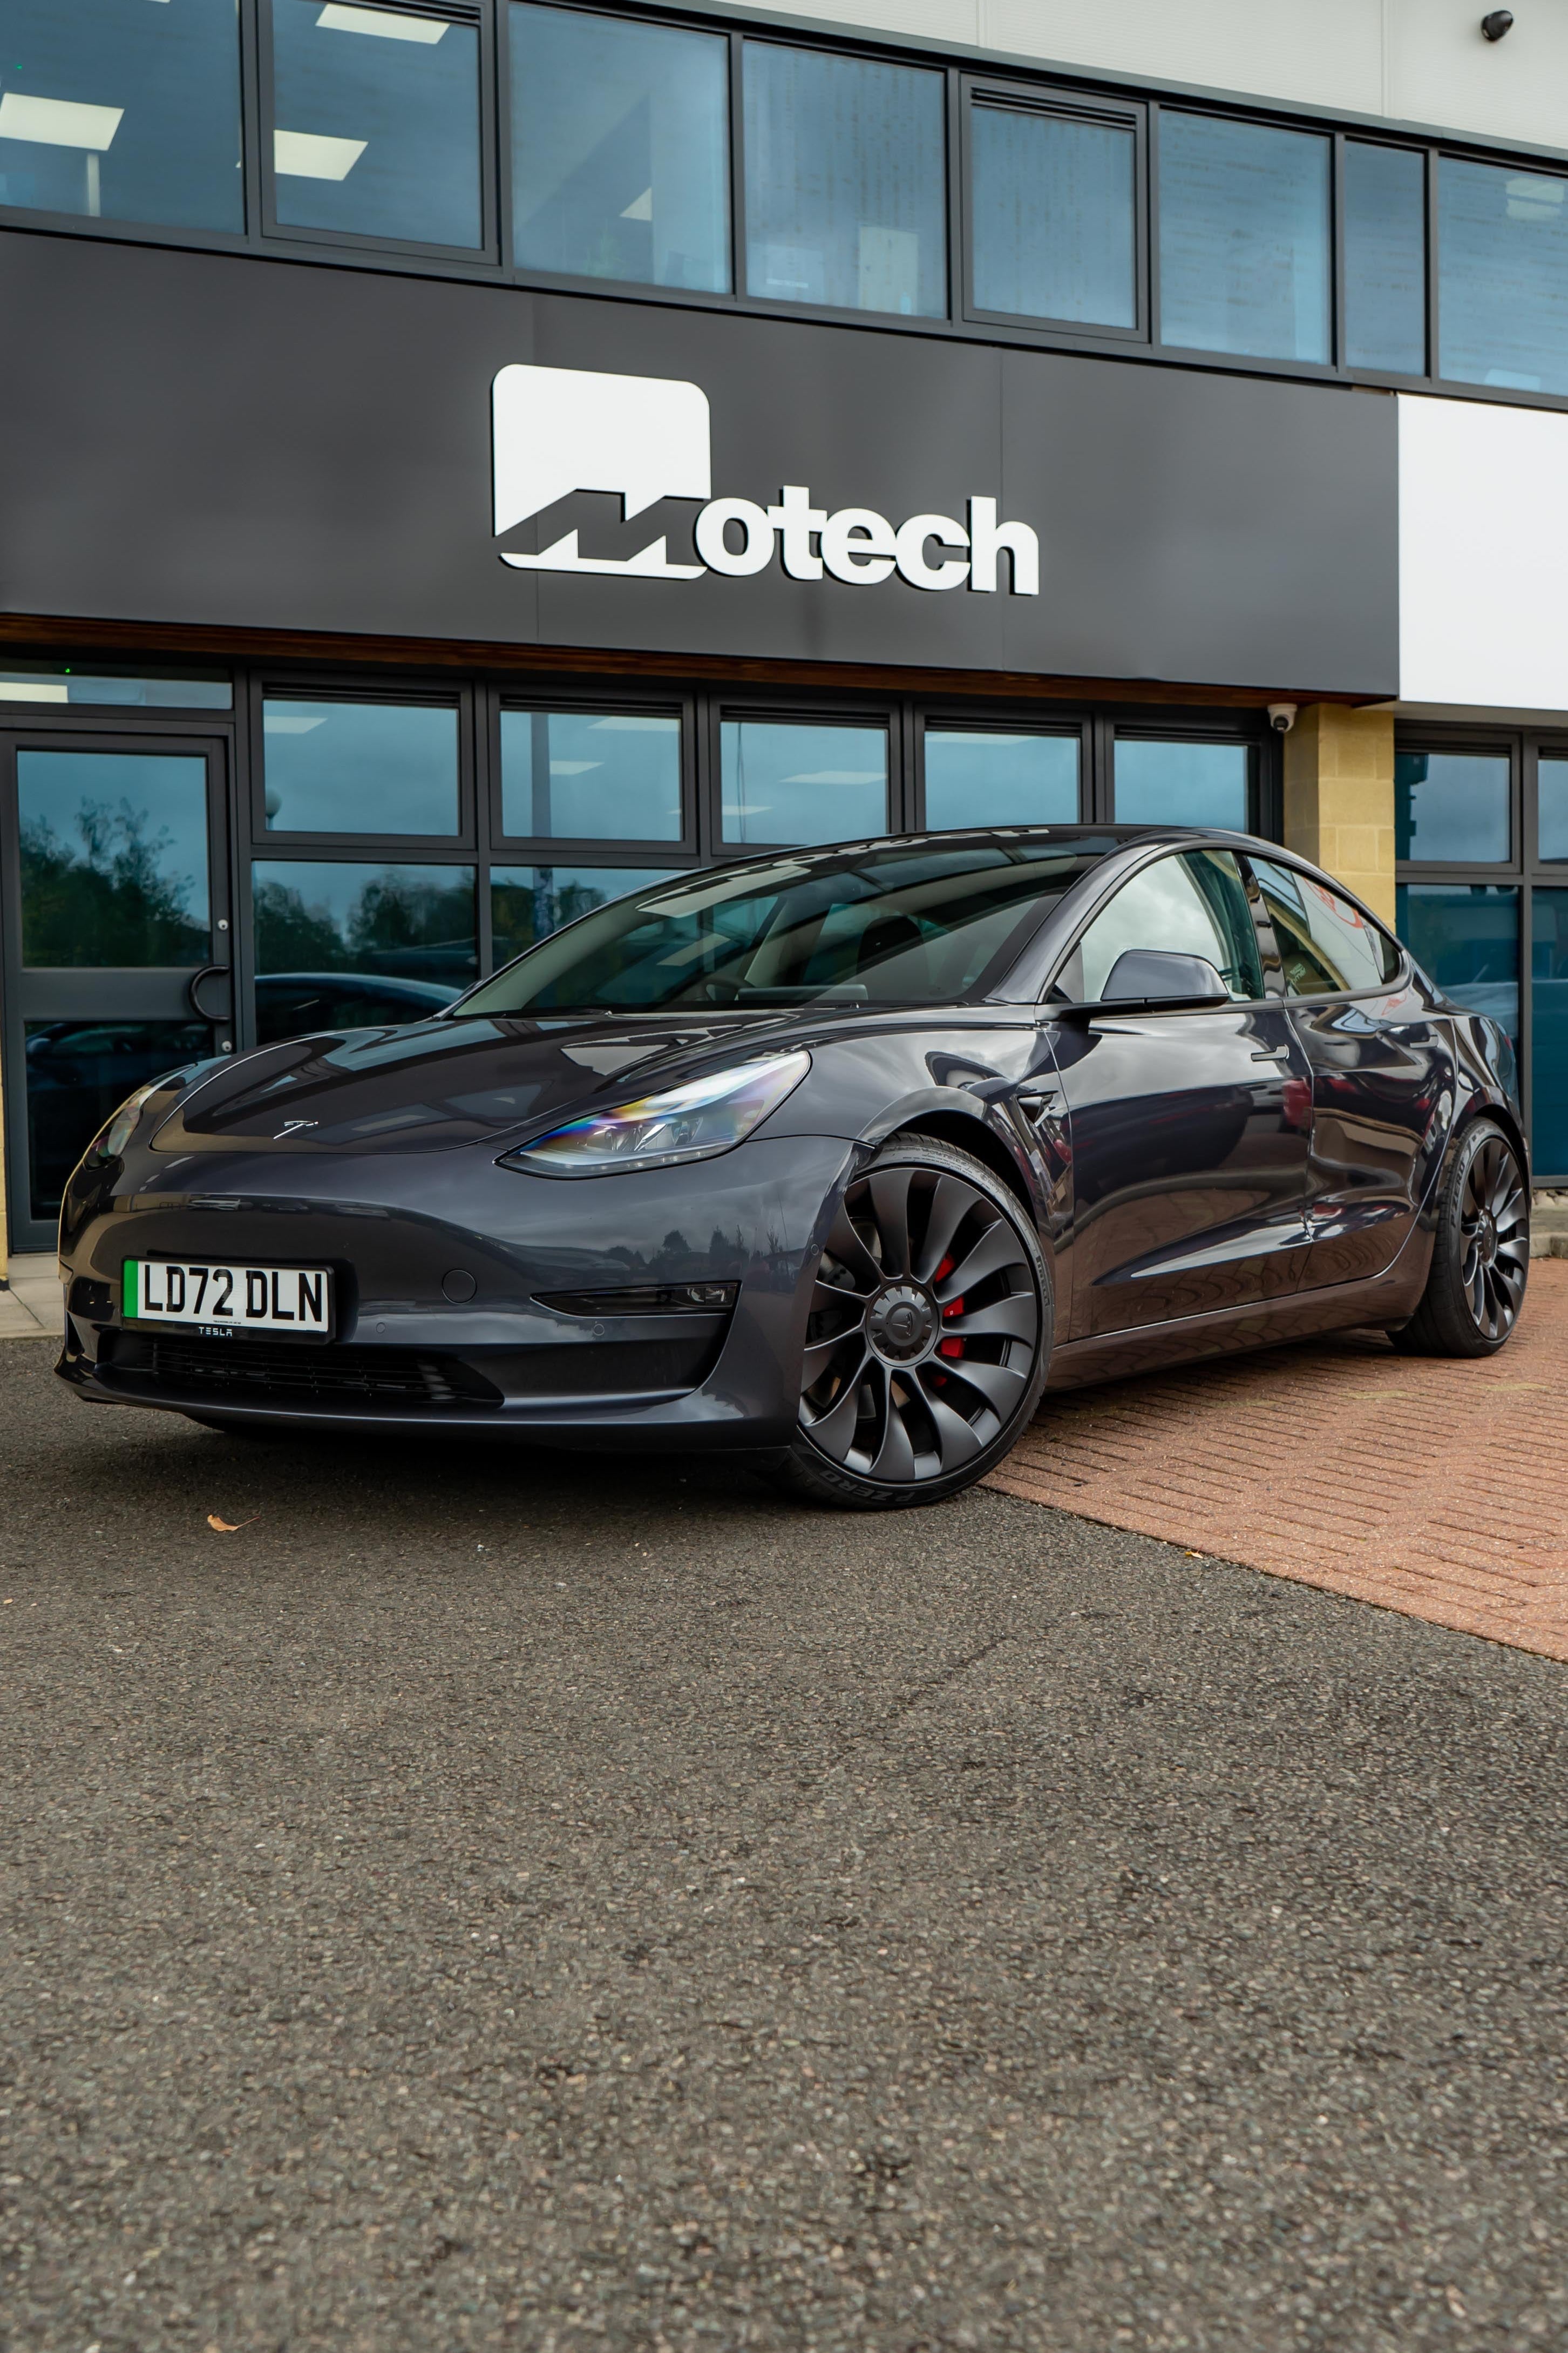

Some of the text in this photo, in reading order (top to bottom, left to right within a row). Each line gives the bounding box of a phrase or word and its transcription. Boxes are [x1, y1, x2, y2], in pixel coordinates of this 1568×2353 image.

[144, 1264, 322, 1322] LD72 DLN
[199, 1327, 232, 1337] TESLA
